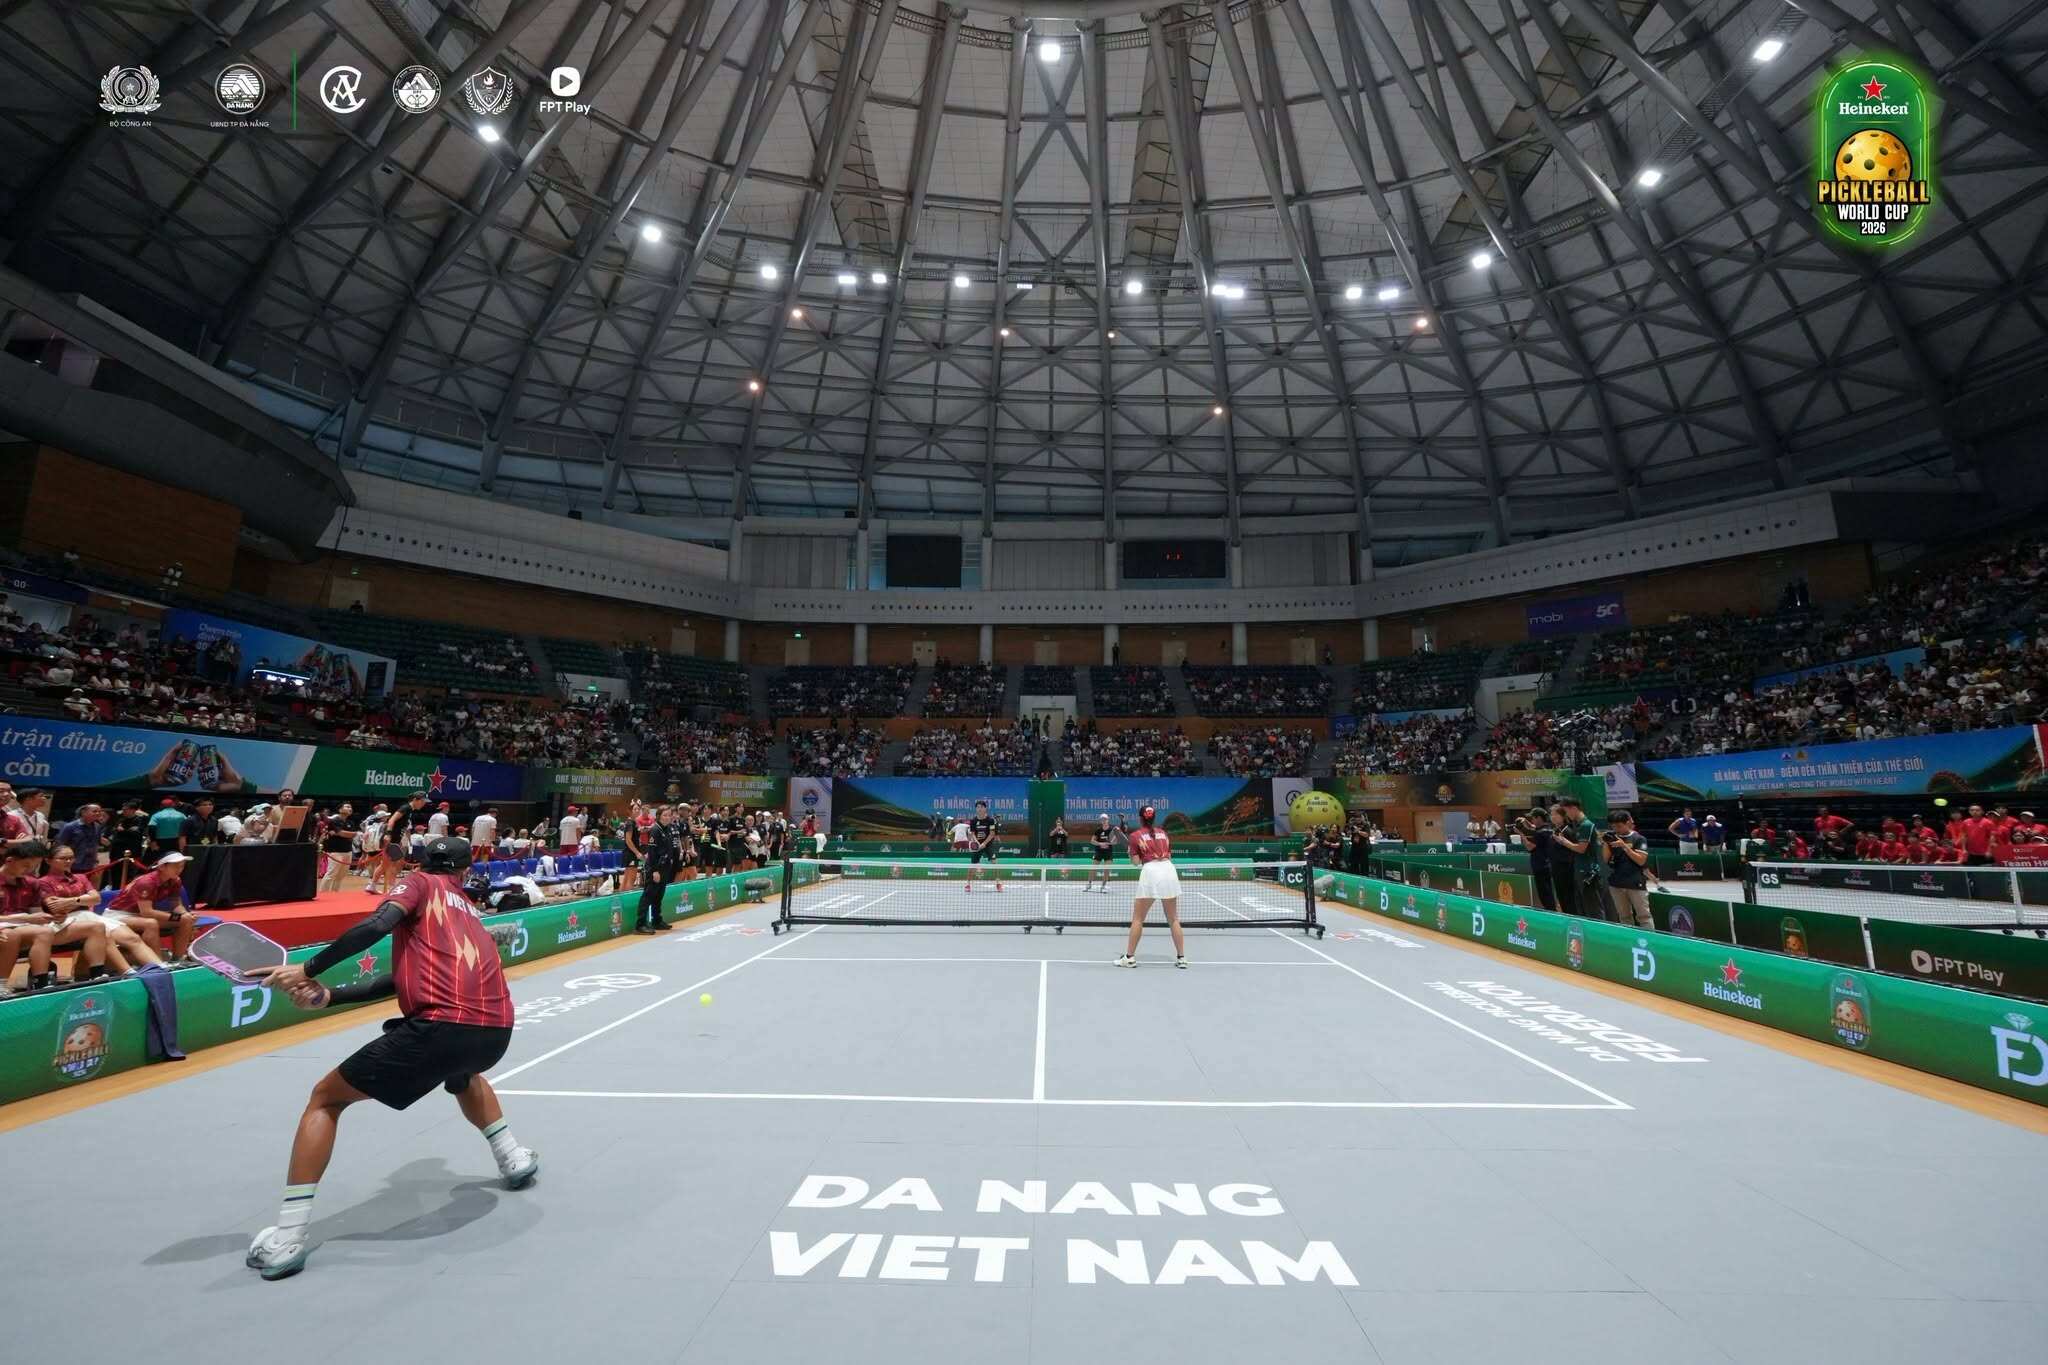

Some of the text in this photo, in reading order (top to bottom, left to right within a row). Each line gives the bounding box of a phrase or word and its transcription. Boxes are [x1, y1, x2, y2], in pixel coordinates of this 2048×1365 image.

[1, 727, 147, 755] trận đỉnh cao
[4, 753, 51, 777] cồn
[364, 769, 425, 788] Heineken
[1287, 873, 1304, 884] CC
[1760, 872, 1780, 885] GS
[558, 928, 587, 945] Heineken
[1508, 932, 1537, 950] Heineken
[1934, 956, 2005, 987] FPT Play
[1703, 981, 1763, 1011] Heineken
[1456, 981, 1712, 1063] FEDERATION
[787, 1174, 1286, 1217] DA NANG
[769, 1230, 1361, 1287] VIET NAM
